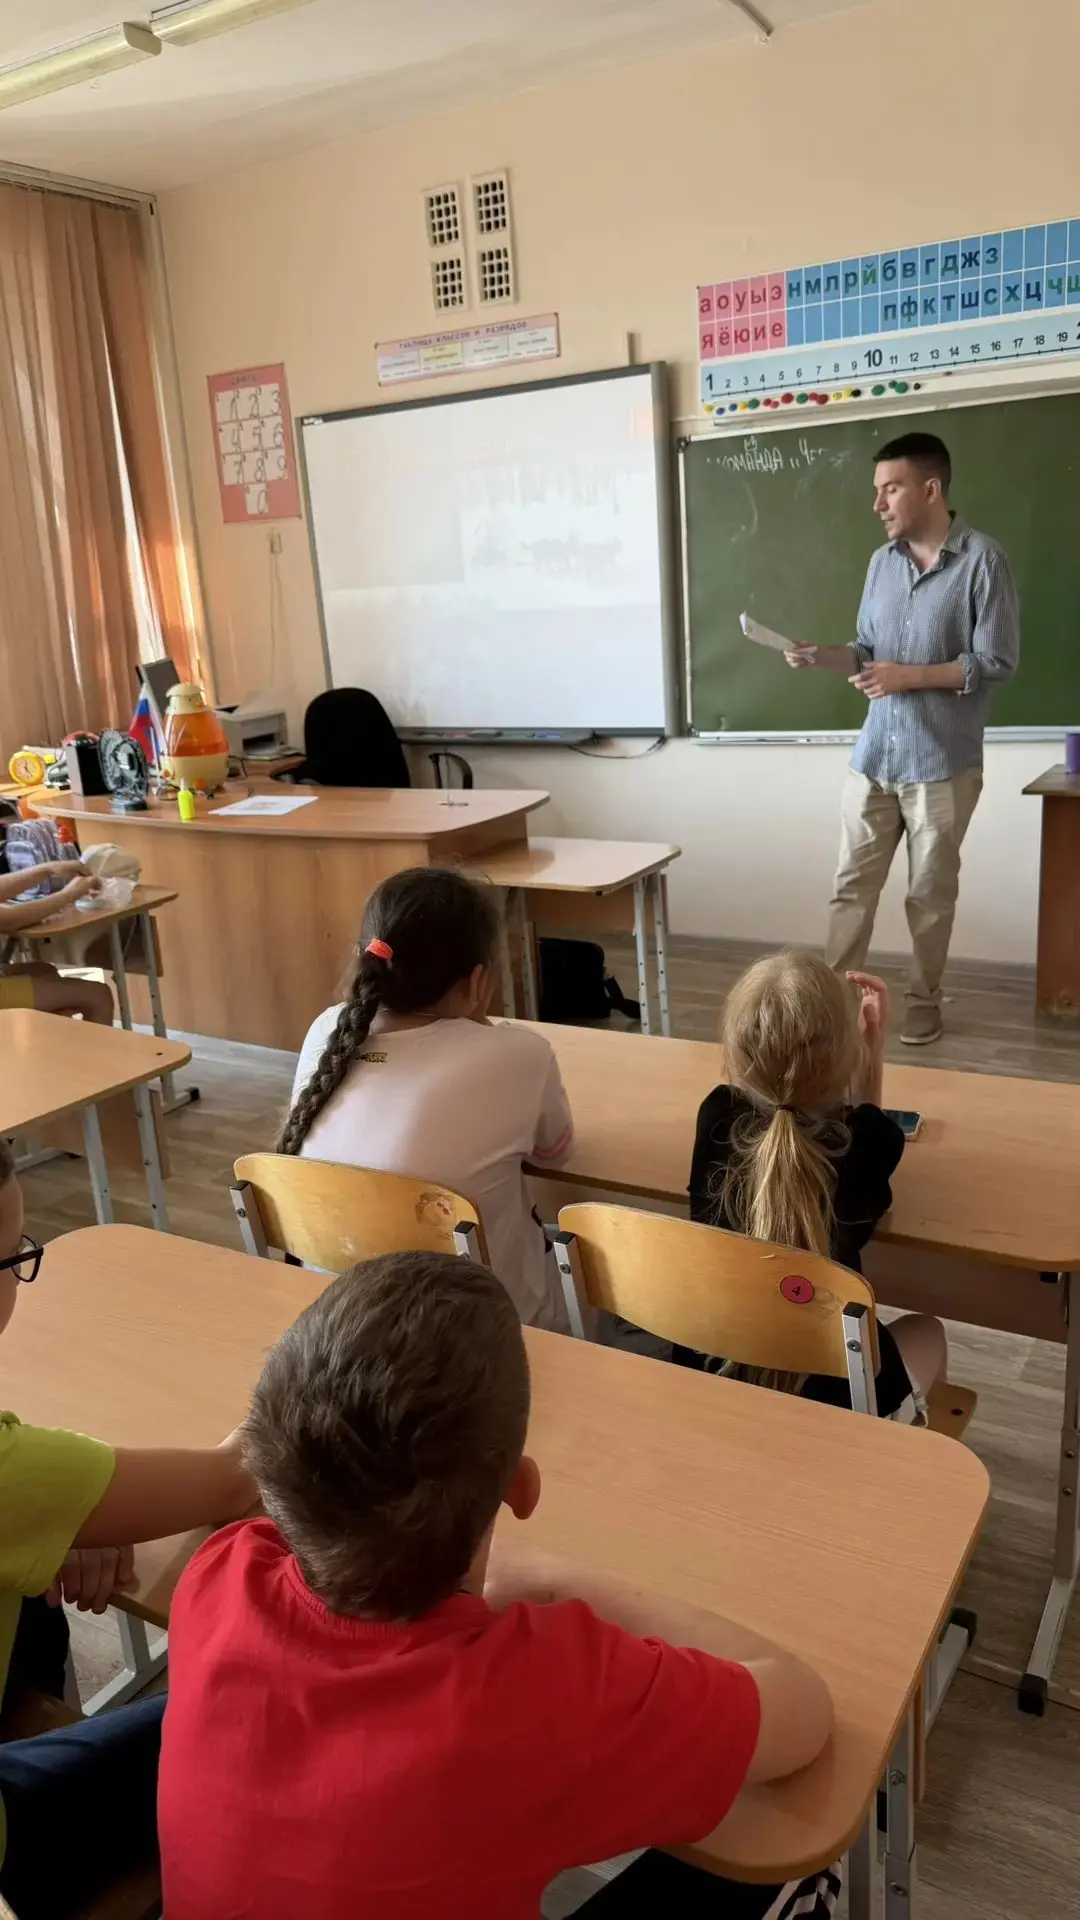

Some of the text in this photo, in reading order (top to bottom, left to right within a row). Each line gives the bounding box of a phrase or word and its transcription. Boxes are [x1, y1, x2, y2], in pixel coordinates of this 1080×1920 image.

[705, 332, 1068, 391] 1 2 3 4 5 6 7 8 9 10 11 12 13 14 15 16 17 18 19
[791, 1285, 801, 1297] 4
